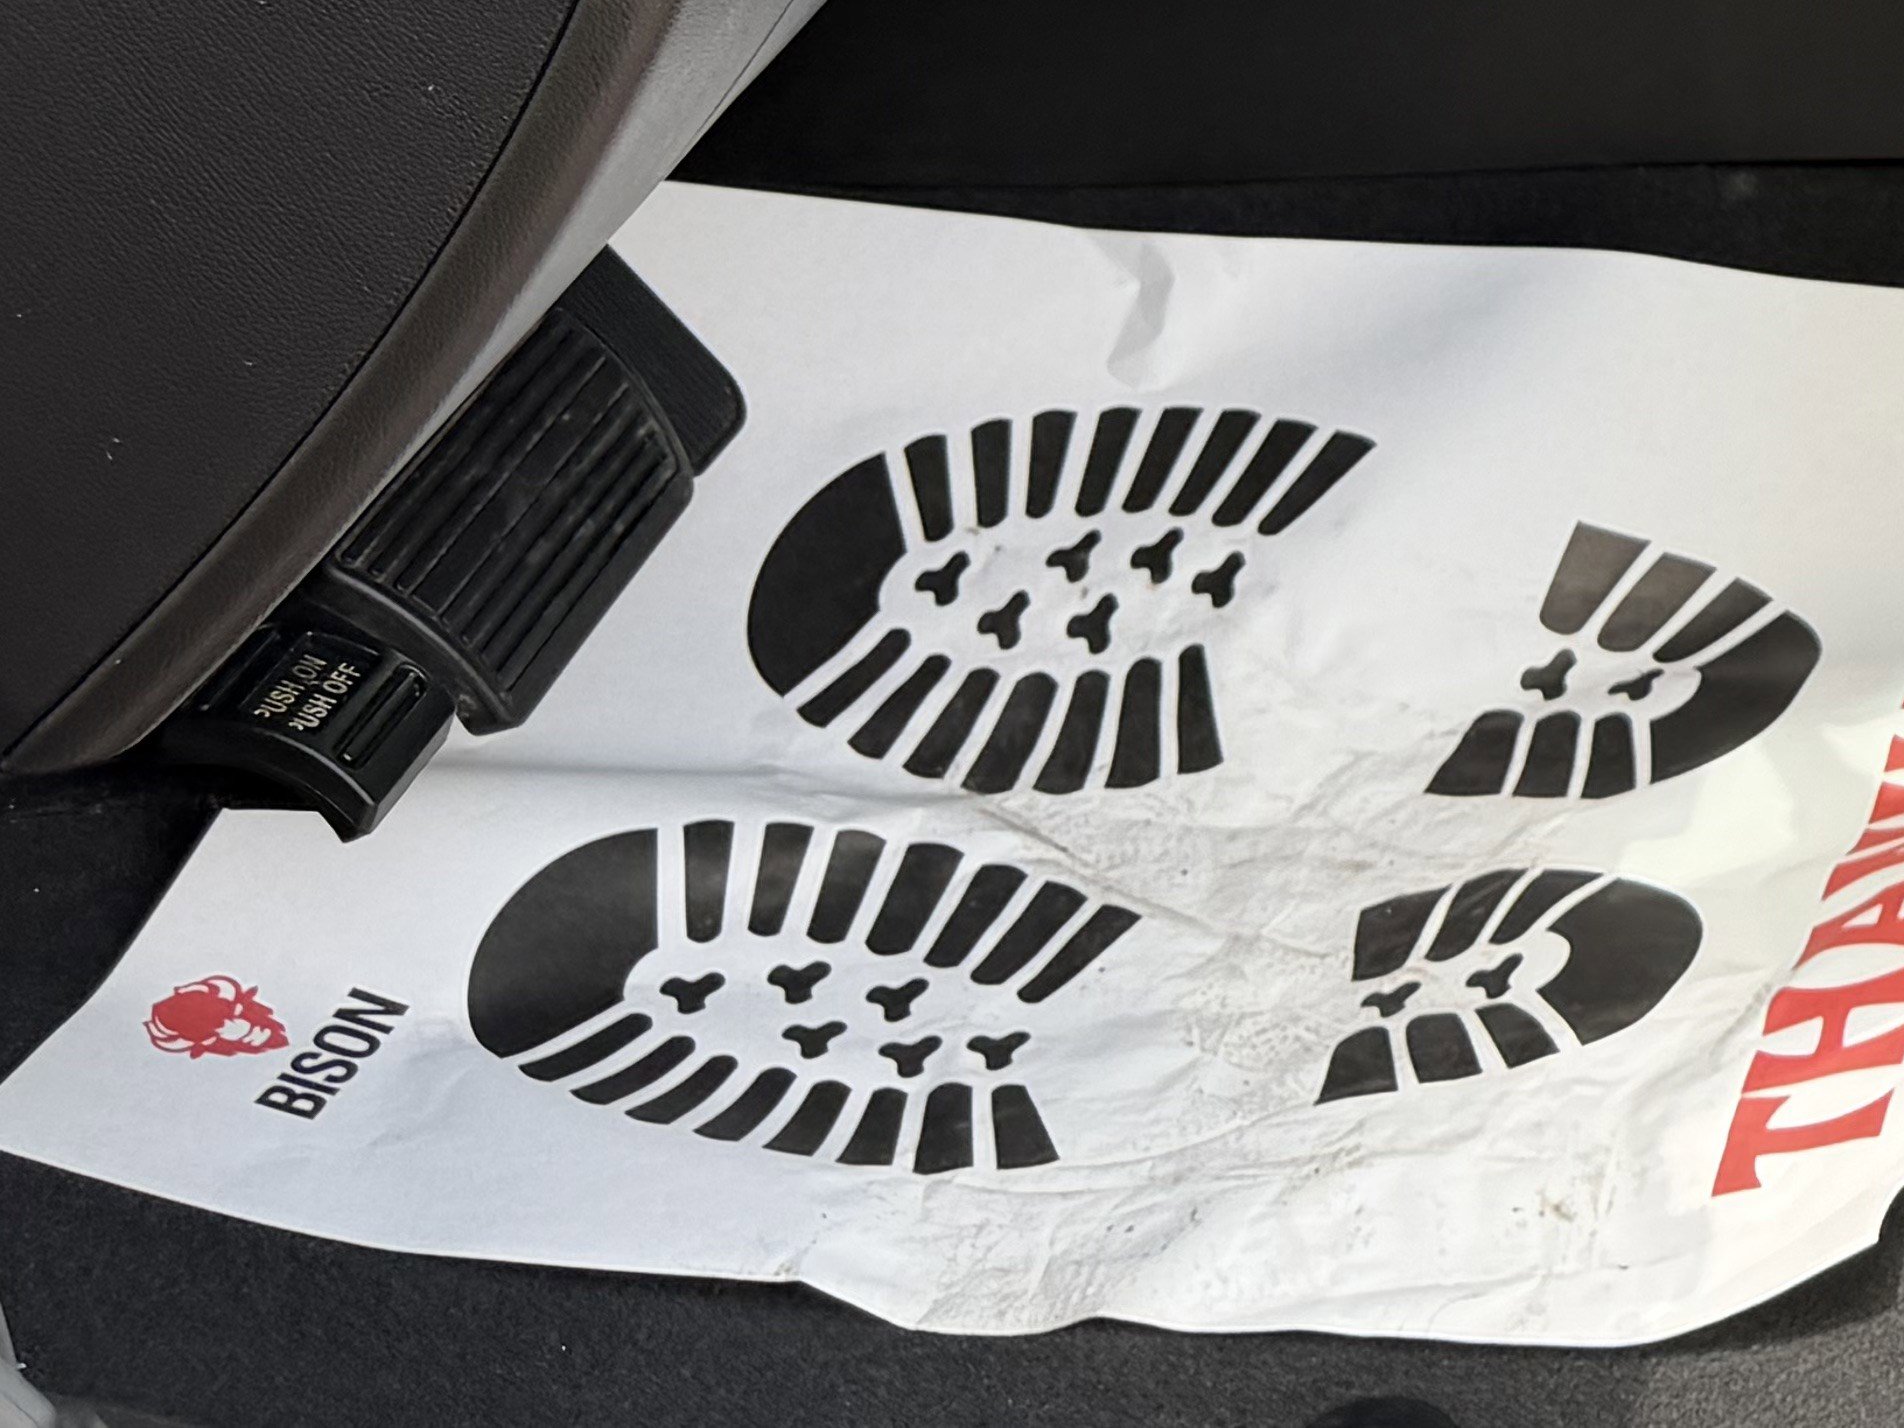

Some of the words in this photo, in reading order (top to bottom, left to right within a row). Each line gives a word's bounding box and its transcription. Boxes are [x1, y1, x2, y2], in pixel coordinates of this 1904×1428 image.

[292, 653, 328, 680] ON
[322, 662, 361, 694] OFF
[253, 986, 410, 1121] BISON
